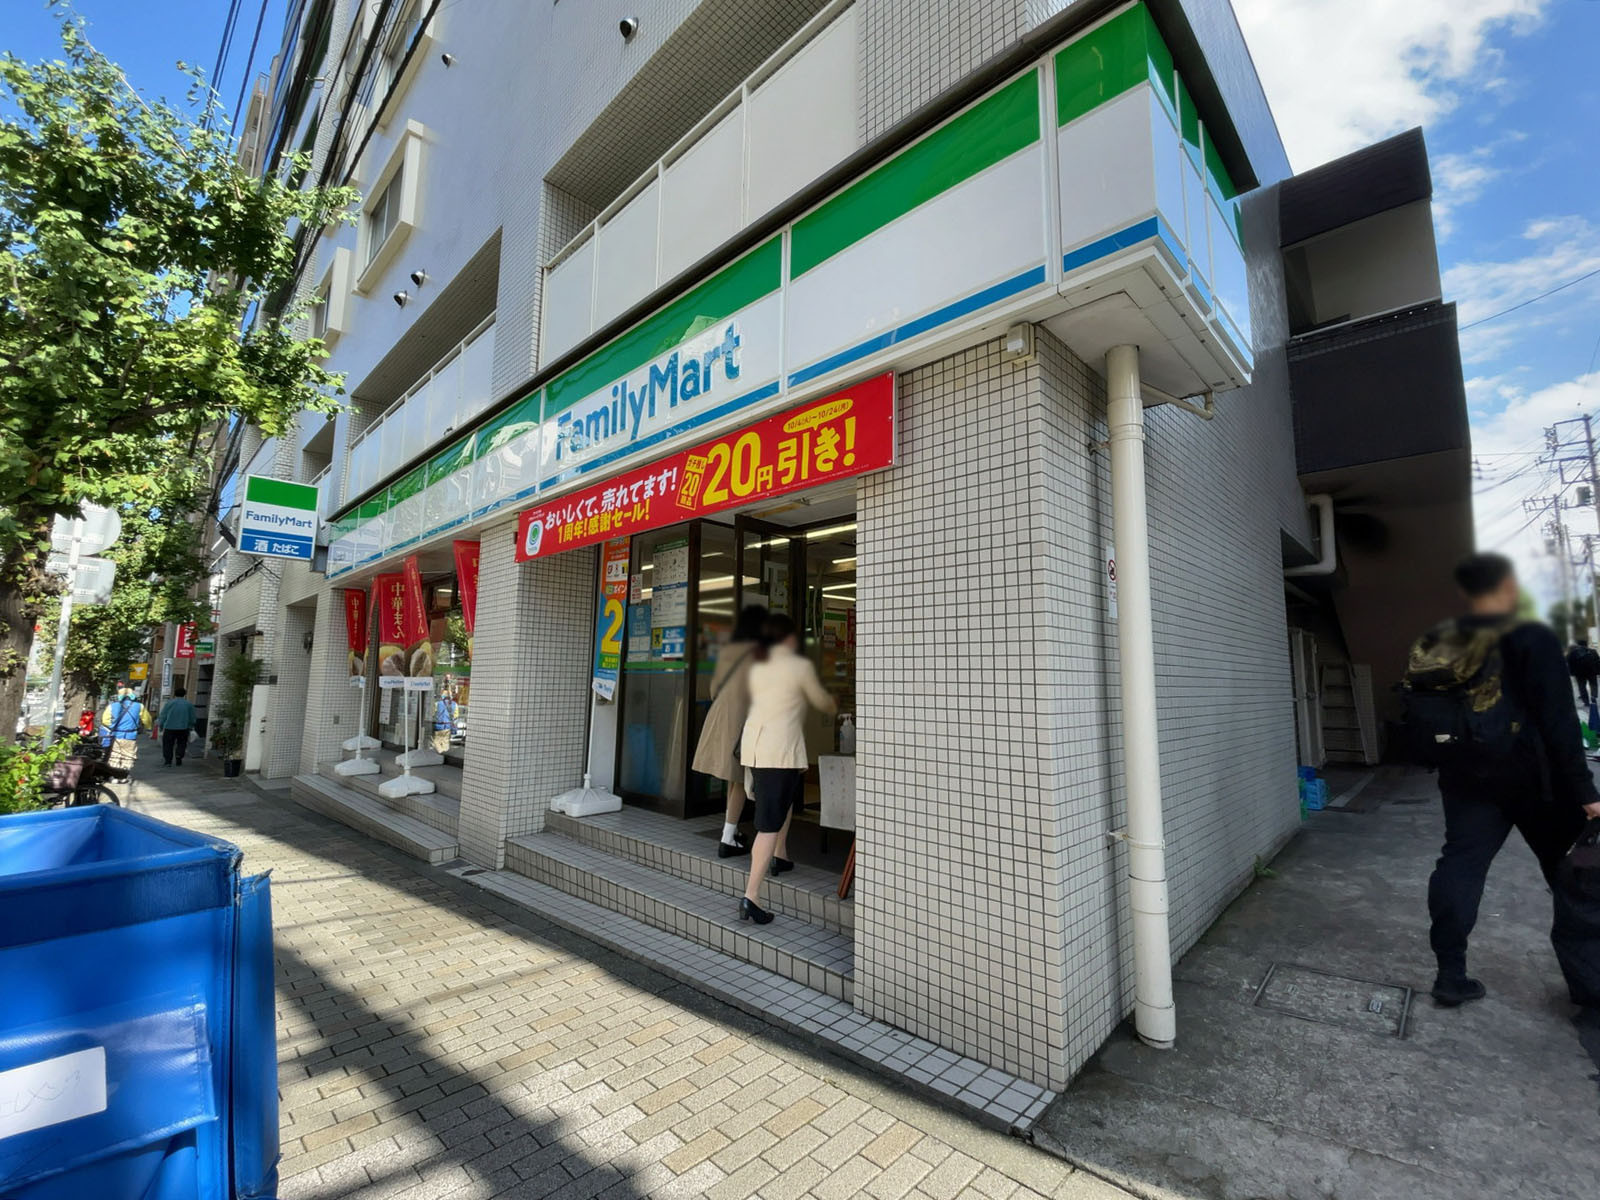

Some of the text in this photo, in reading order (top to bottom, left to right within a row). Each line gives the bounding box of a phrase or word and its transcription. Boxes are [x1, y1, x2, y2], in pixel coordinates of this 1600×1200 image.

[555, 324, 740, 461] FamilyMart
[681, 472, 700, 497] 20
[246, 510, 312, 529] FamilyMart
[254, 539, 300, 555] 酒 たばこ
[601, 598, 624, 654] 2
